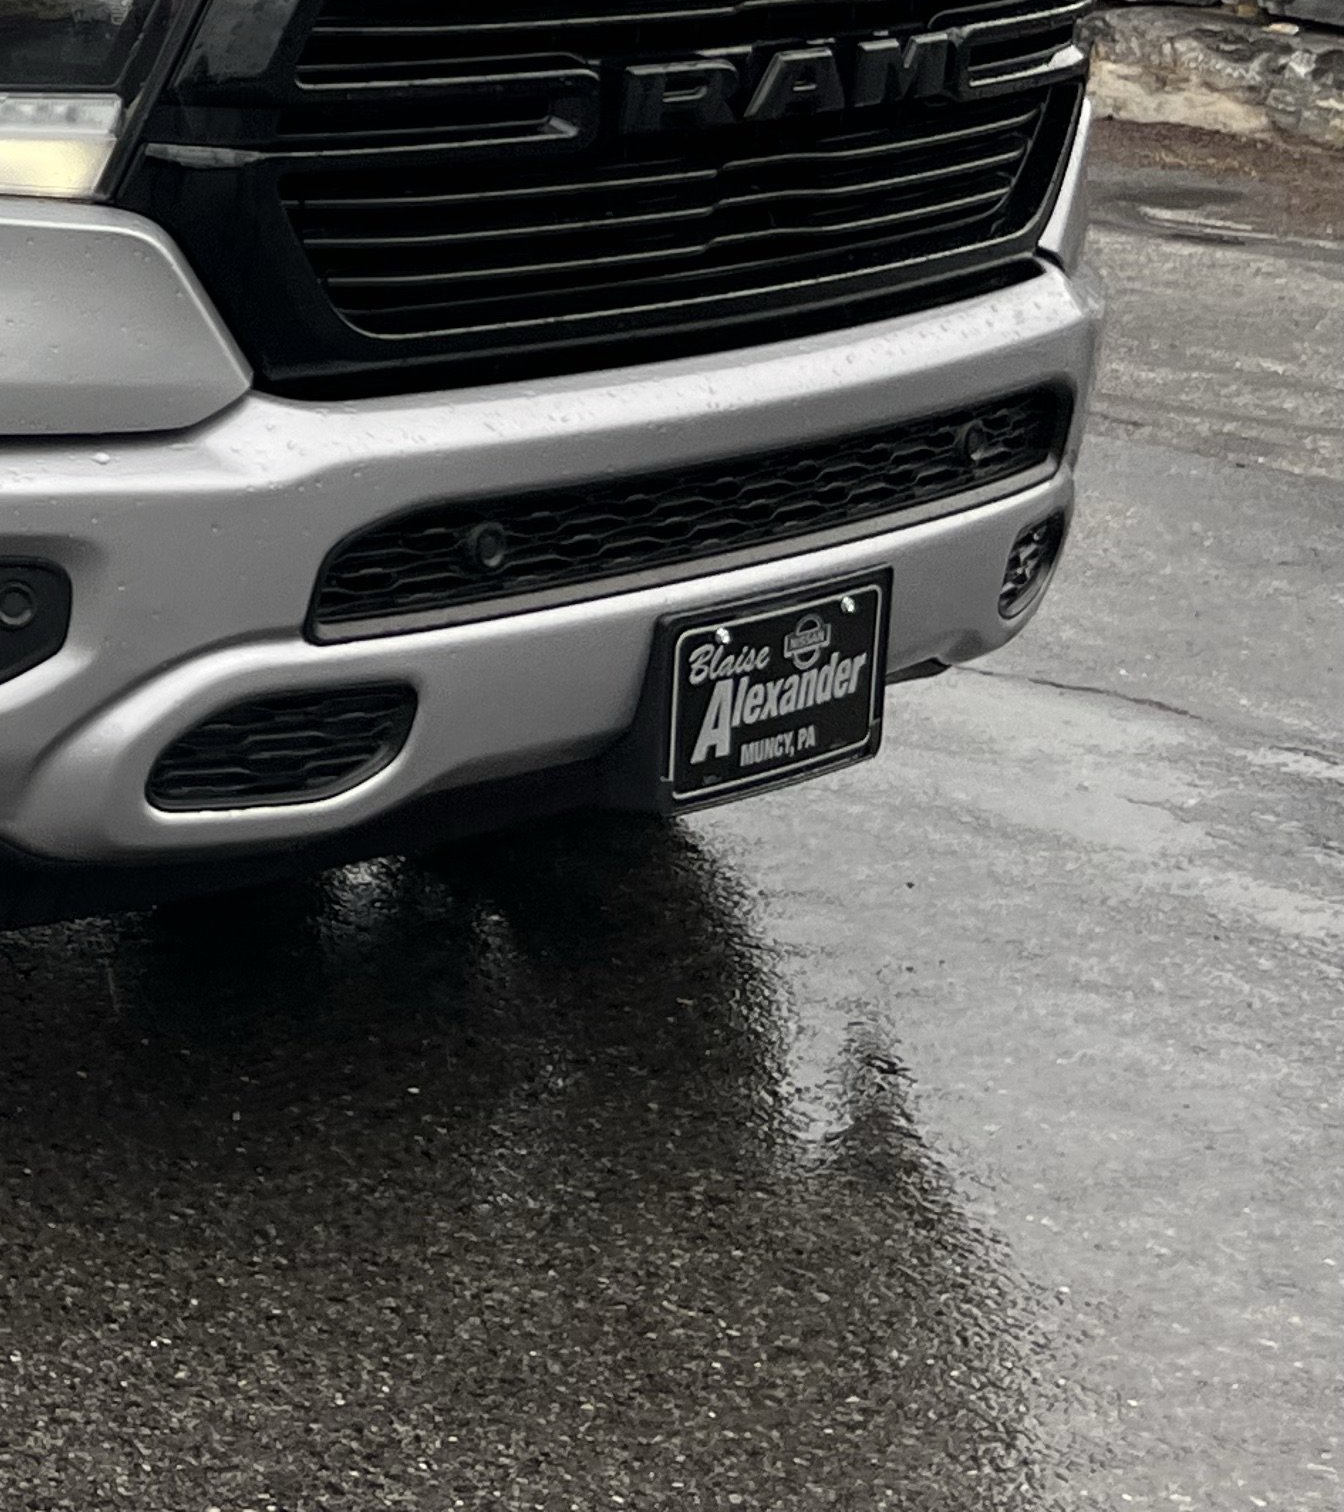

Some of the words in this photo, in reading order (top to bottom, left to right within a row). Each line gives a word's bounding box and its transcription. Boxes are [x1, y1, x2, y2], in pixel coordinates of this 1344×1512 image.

[620, 31, 953, 133] RAM
[689, 643, 771, 685] Blaise
[690, 651, 867, 764] Alexander
[739, 730, 794, 766] MUNCY,
[797, 725, 817, 752] PA
